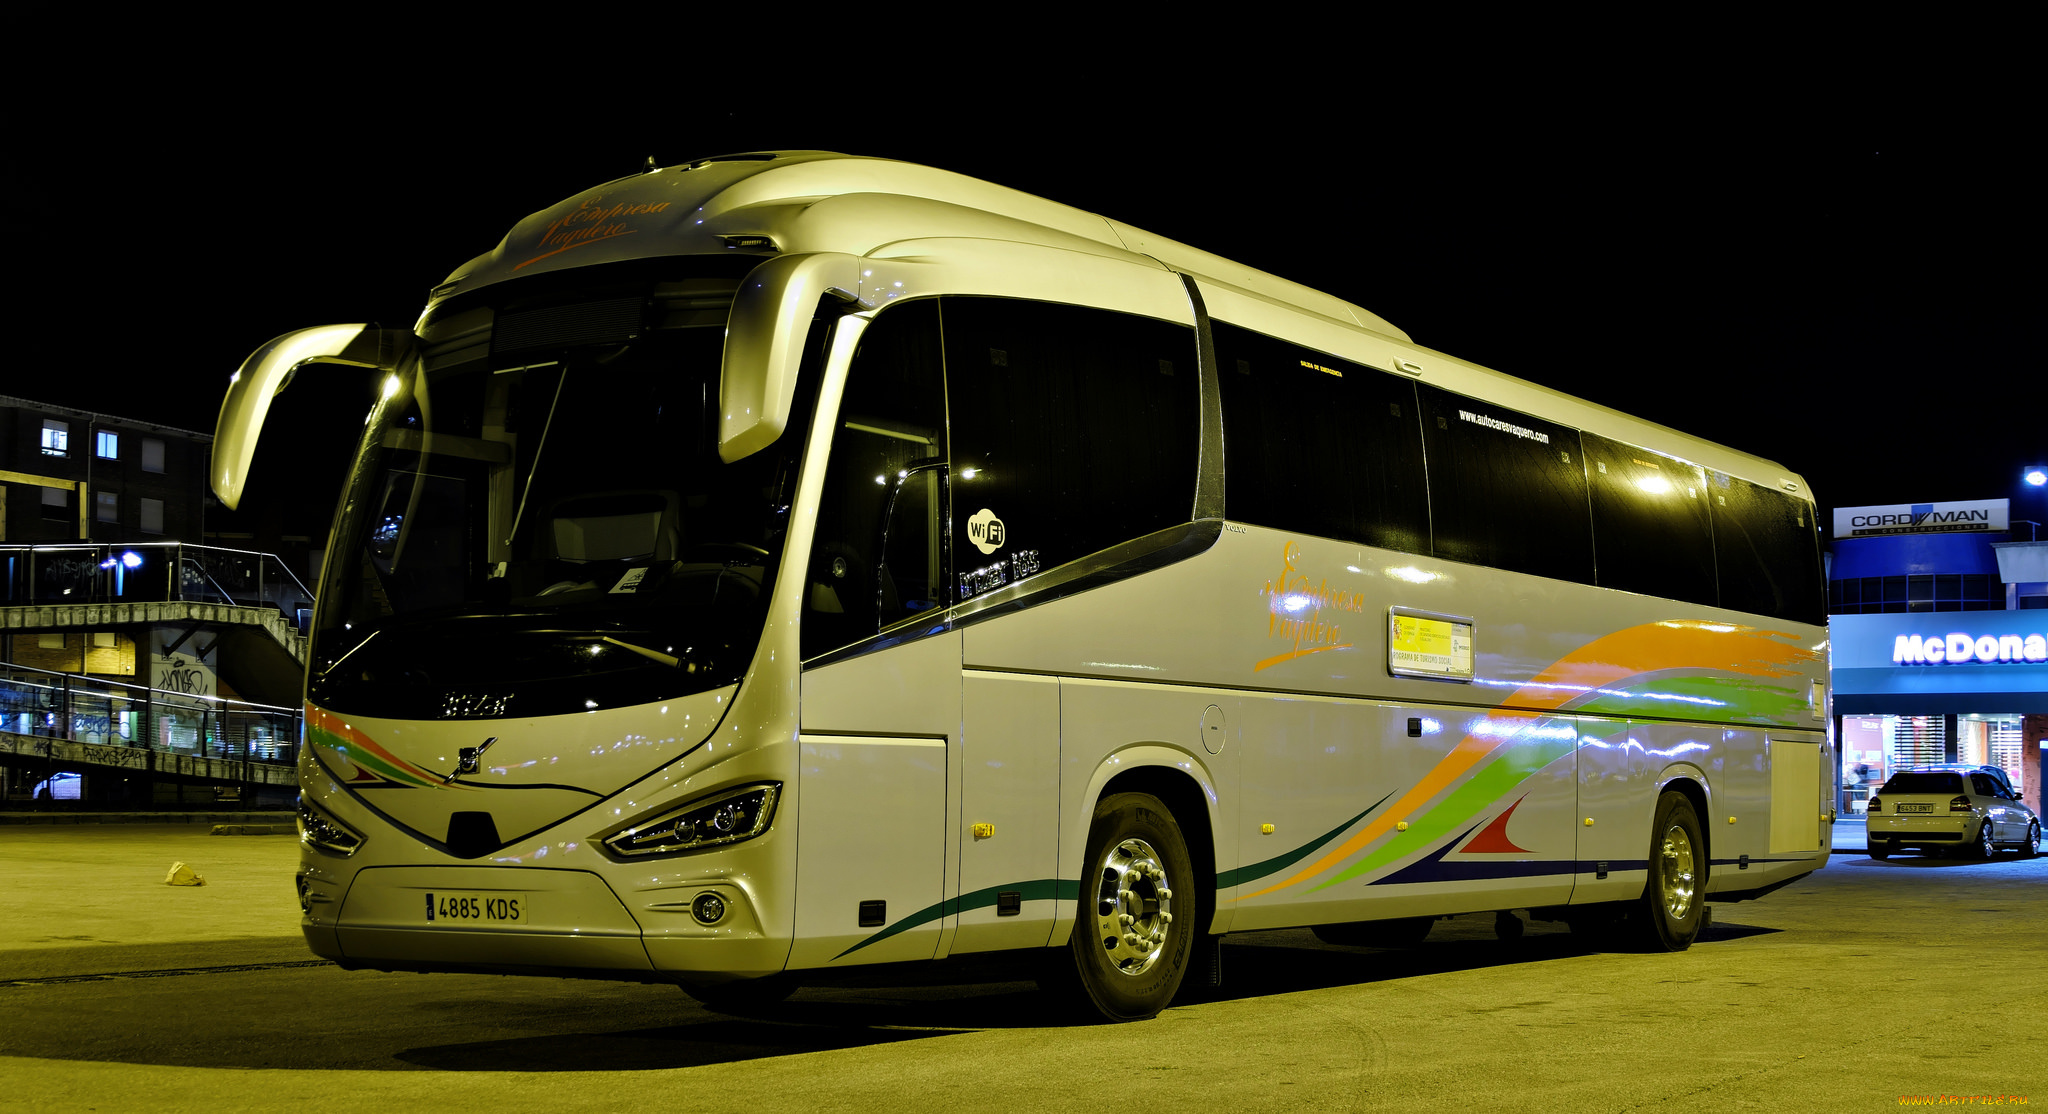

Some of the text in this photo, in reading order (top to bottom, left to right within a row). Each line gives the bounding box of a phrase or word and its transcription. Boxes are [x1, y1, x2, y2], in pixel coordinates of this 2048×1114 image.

[1458, 409, 1549, 444] www.autocaresvaquero.com
[1881, 523, 1986, 534] CONSTRUCCIONES
[1893, 632, 2048, 664] McDona
[439, 897, 480, 919] 4885
[486, 898, 520, 920] KDS
